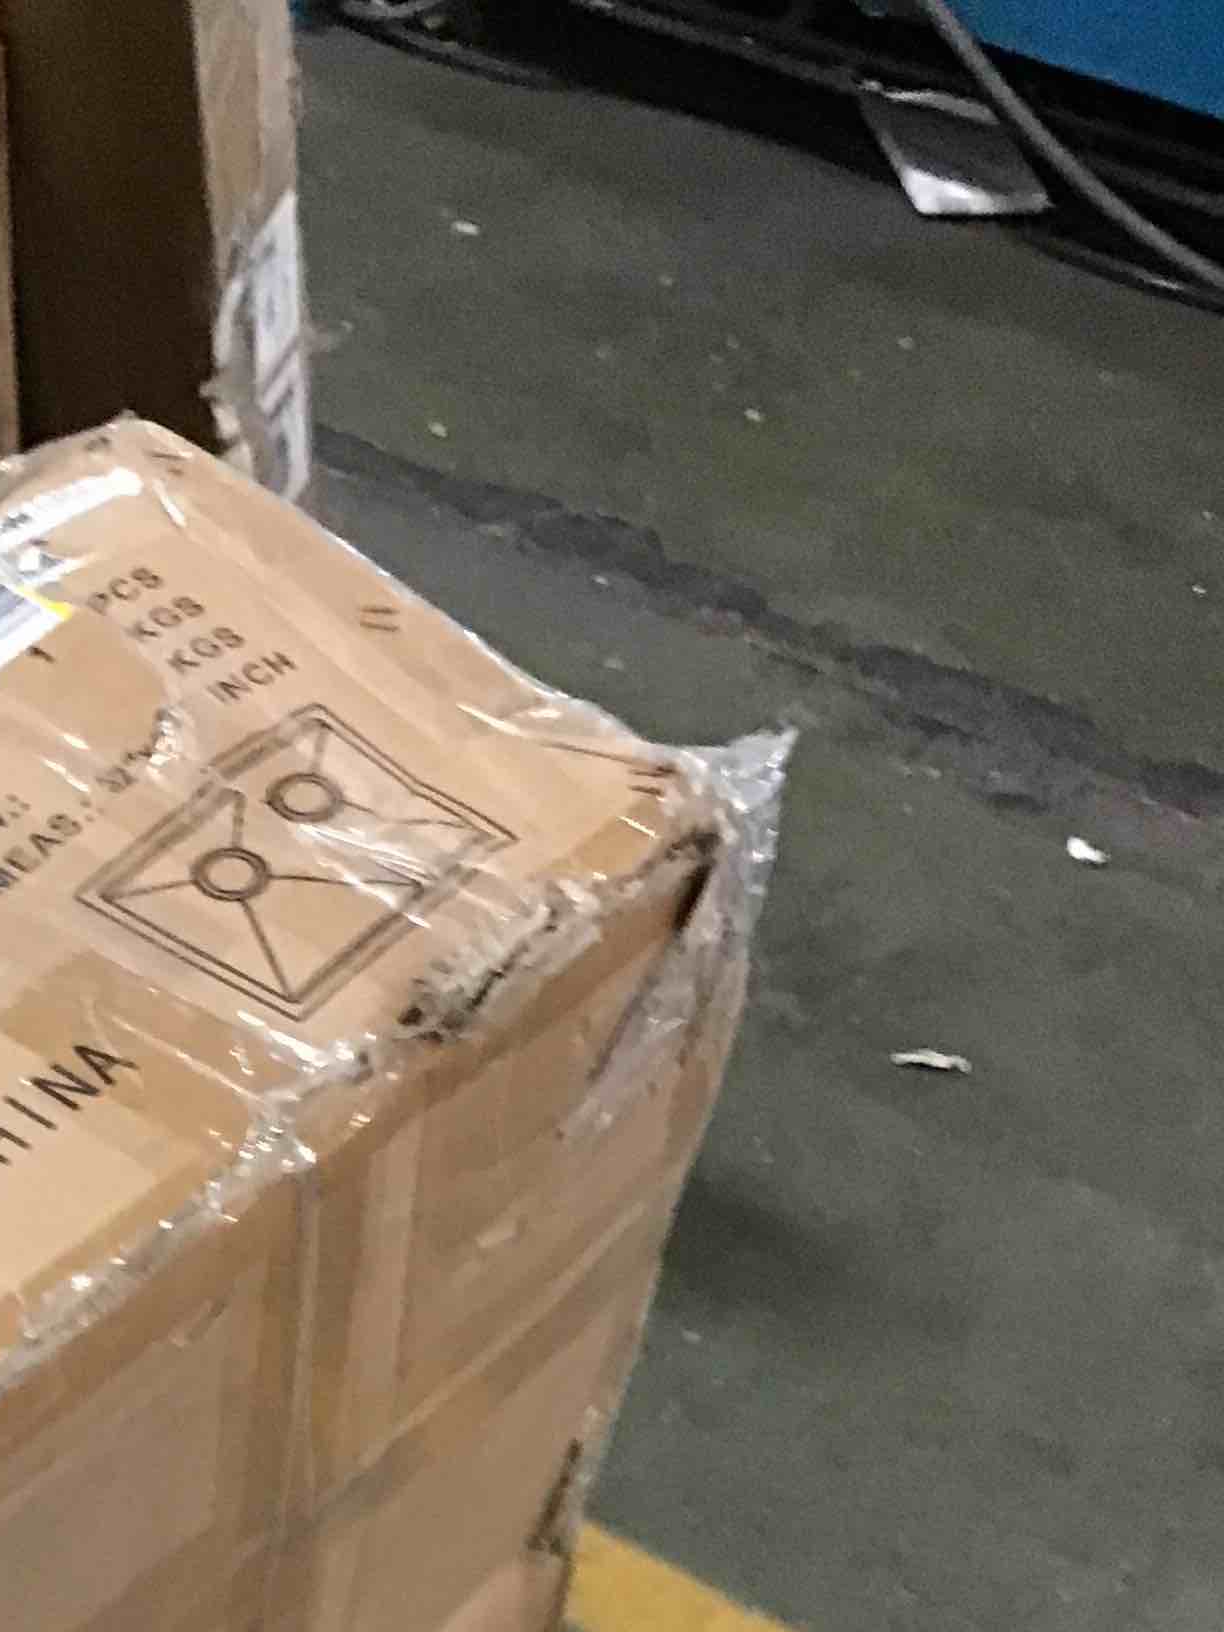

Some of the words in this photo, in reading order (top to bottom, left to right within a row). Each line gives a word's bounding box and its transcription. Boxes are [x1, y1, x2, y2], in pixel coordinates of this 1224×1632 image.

[85, 566, 164, 616] PCS
[126, 595, 207, 643] KGS
[167, 626, 247, 676] KGS
[207, 650, 298, 704] INCH
